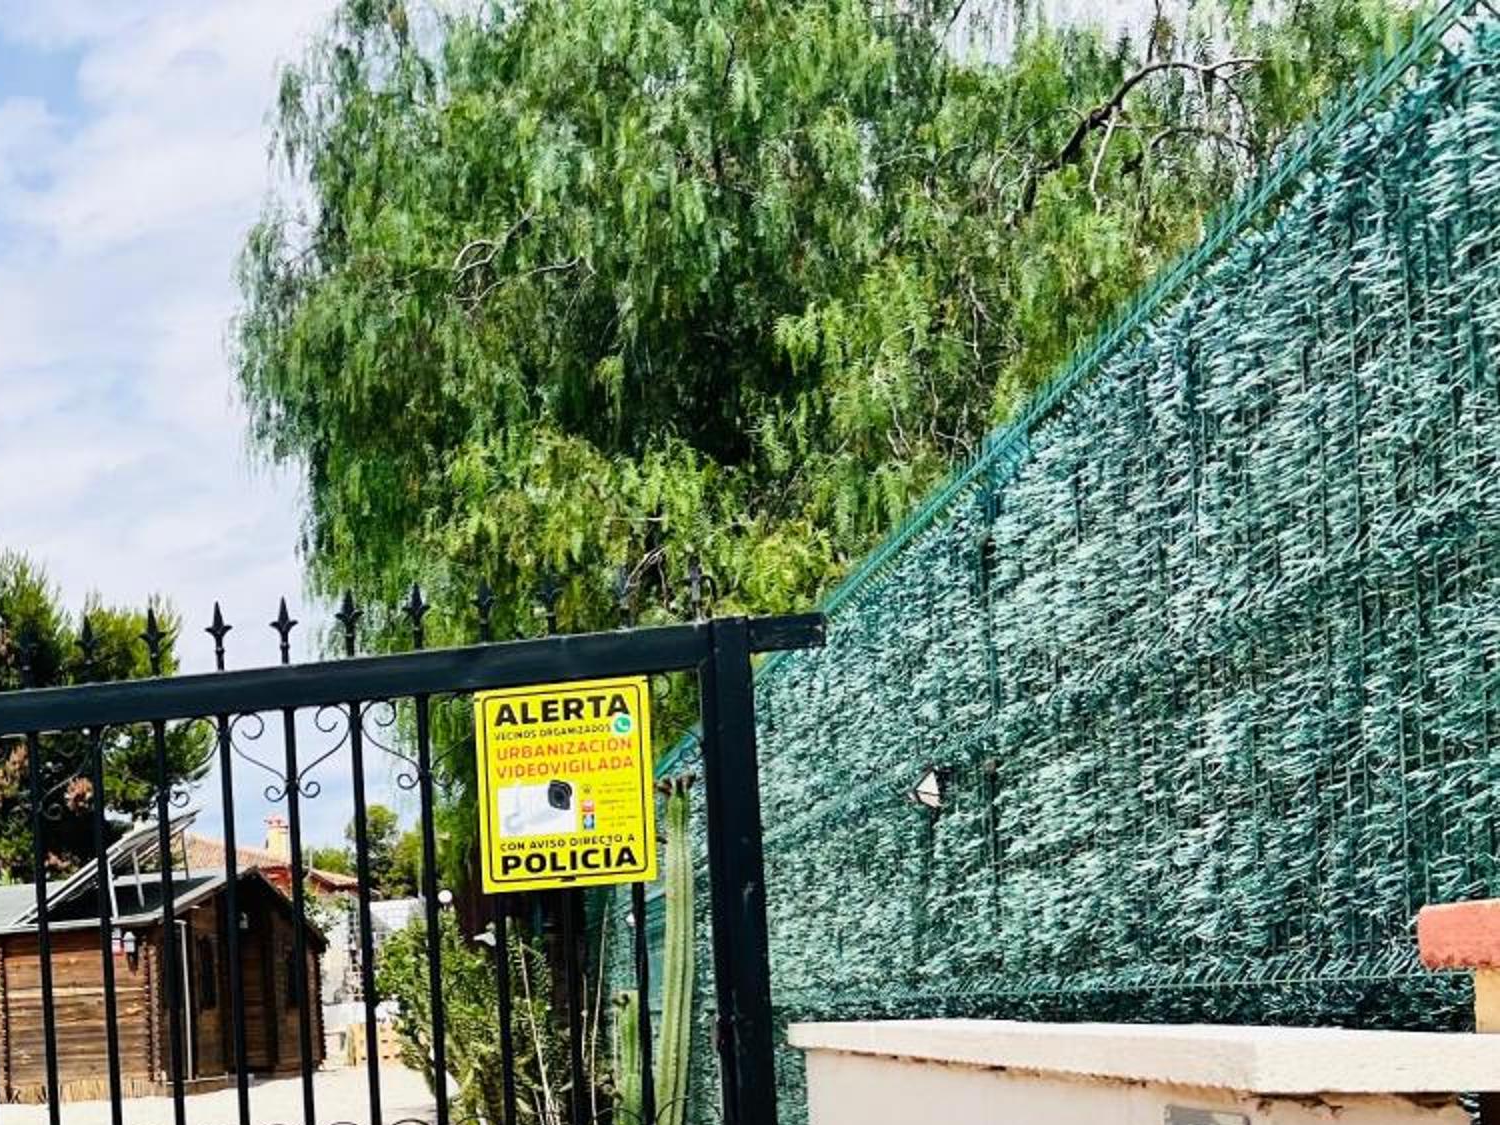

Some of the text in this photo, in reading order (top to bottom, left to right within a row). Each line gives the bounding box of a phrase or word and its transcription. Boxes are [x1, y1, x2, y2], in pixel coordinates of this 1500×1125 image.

[495, 694, 630, 726] ALERTA
[494, 723, 612, 741] VECINOS ORGANIZADOS
[496, 756, 634, 778] VIDEOVIGILADA
[500, 833, 636, 852] CON AVISO DIRECTO A
